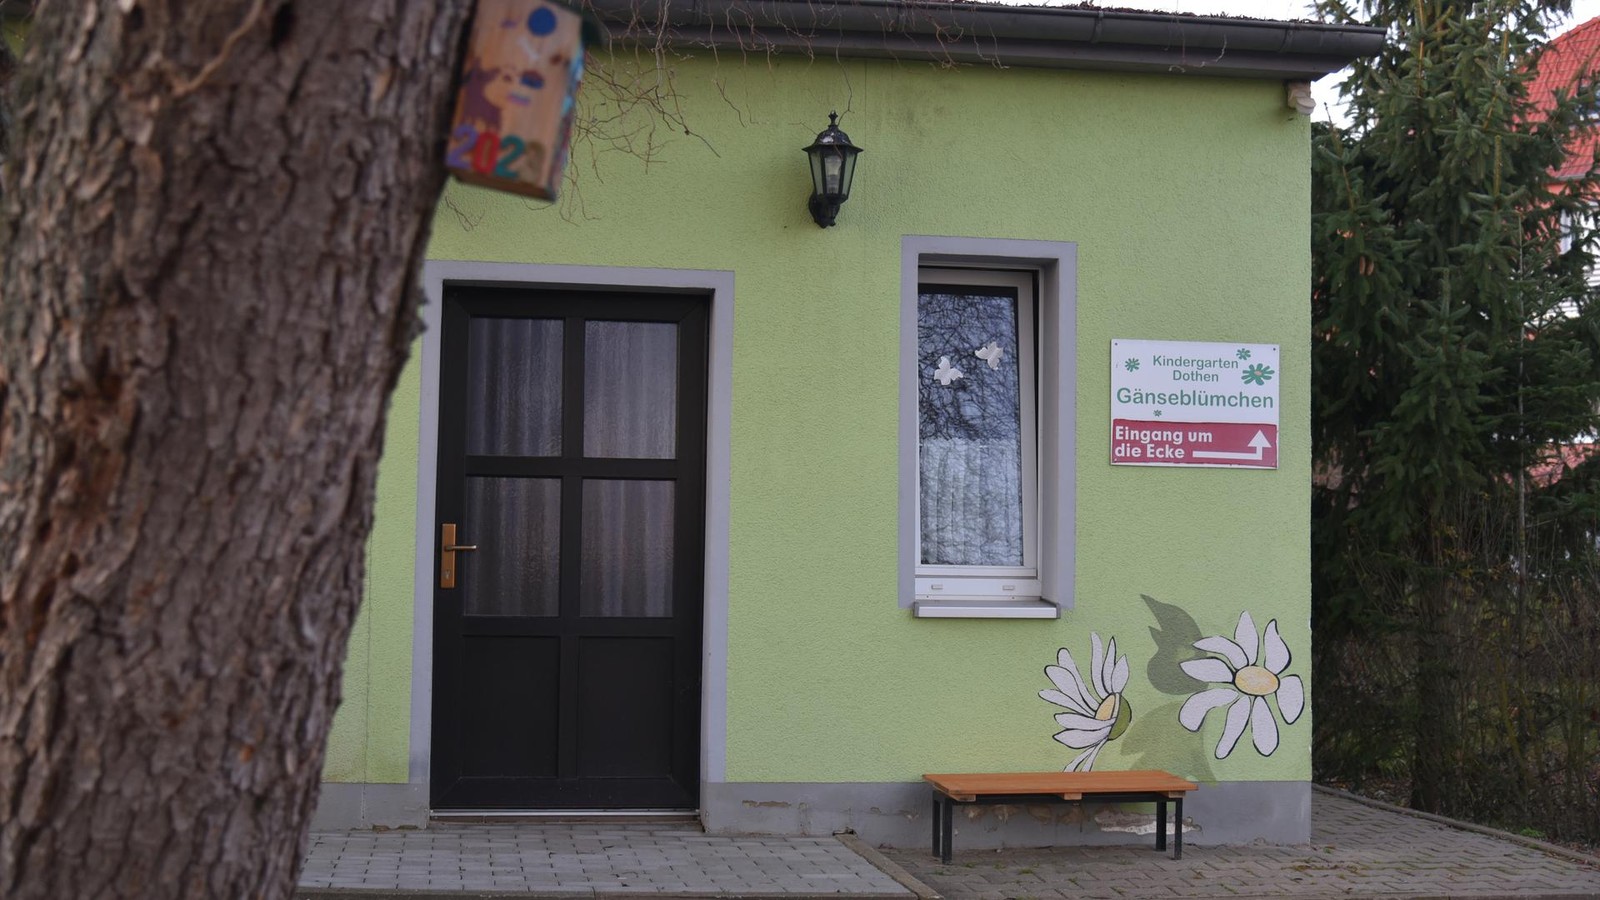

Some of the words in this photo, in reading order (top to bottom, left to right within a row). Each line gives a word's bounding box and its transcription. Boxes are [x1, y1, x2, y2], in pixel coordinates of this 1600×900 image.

[1152, 355, 1239, 370] Kindergarten
[1172, 369, 1219, 382] Dothen
[1116, 387, 1274, 408] Gänseblümchen
[1115, 426, 1183, 444] Eingang
[1188, 432, 1212, 442] um
[1114, 443, 1142, 457] die
[1146, 444, 1185, 458] Ecke
